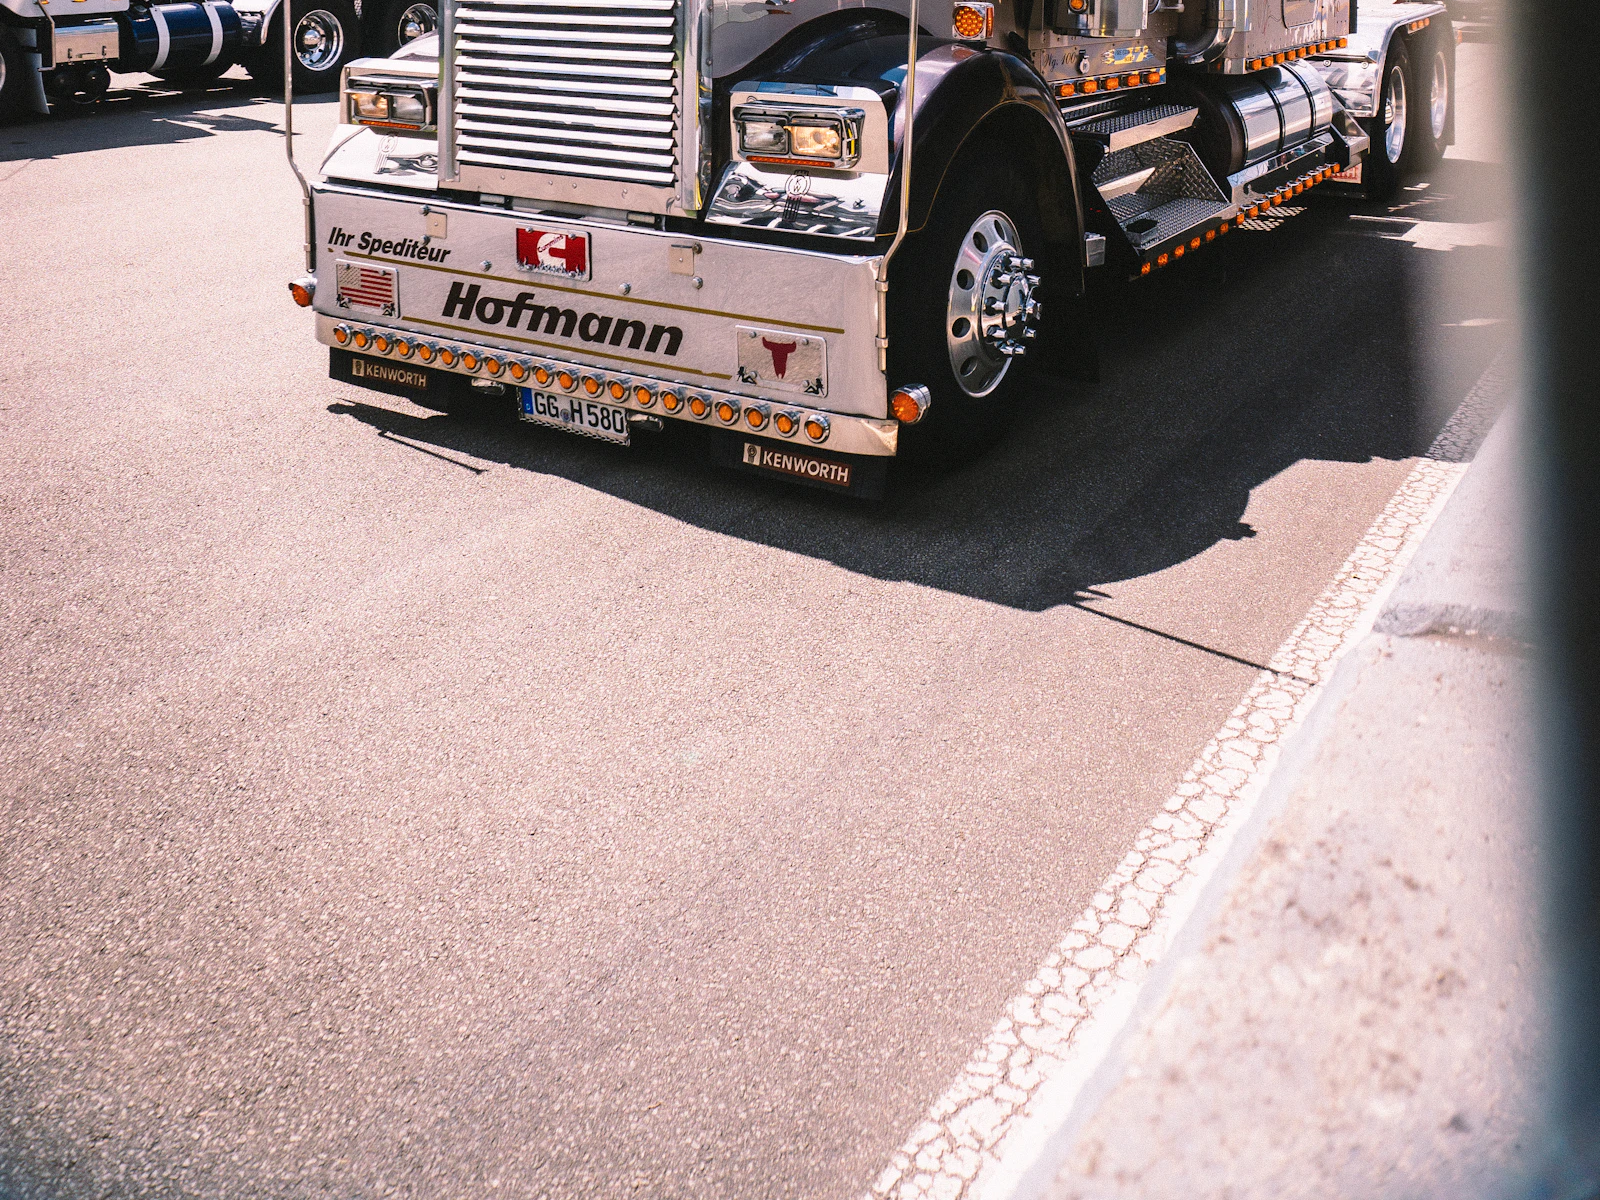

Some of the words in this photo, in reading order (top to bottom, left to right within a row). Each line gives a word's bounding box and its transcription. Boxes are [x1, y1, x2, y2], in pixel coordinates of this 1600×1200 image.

[328, 226, 355, 247] Ihr
[357, 231, 452, 263] Spediteur
[442, 281, 684, 357] Hofmann
[366, 363, 427, 387] KENWORTH
[534, 392, 560, 419] GG
[569, 399, 584, 425] H
[586, 403, 625, 434] 580
[763, 450, 849, 483] KENWORTH
